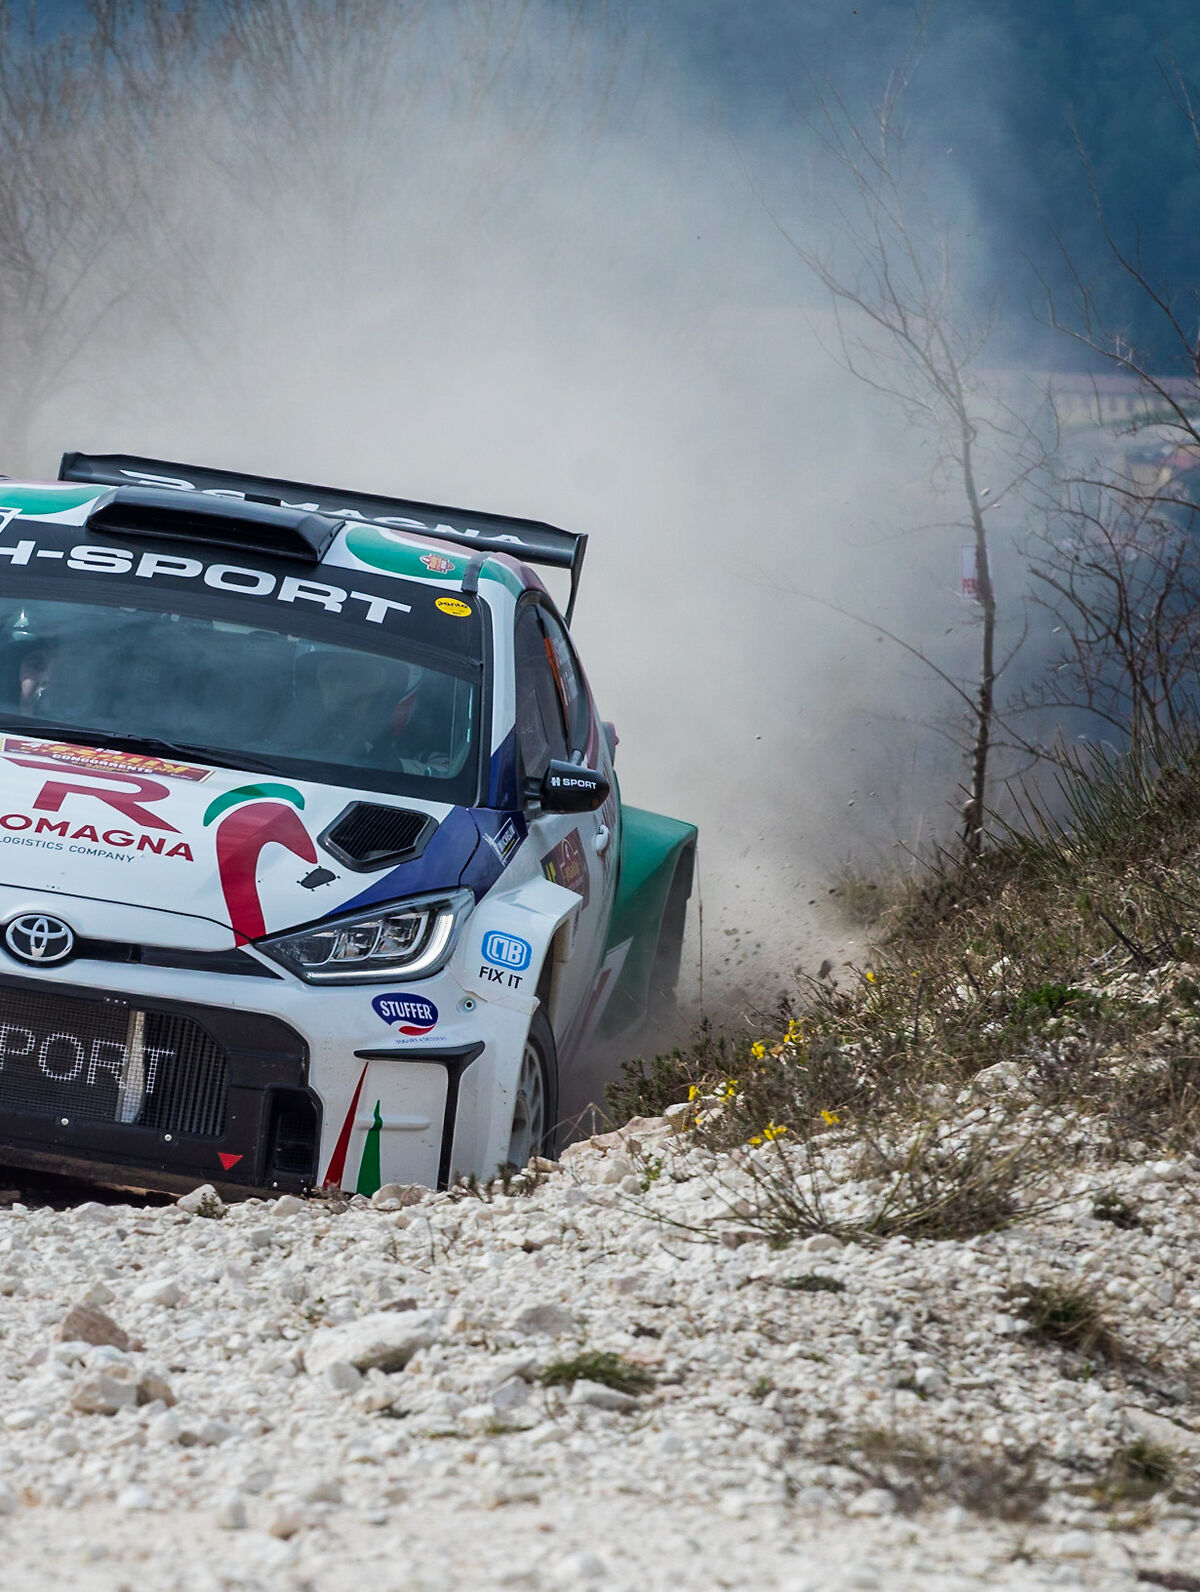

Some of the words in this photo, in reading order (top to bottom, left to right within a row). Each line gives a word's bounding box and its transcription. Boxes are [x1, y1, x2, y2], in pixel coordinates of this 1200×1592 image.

[51, 753, 154, 774] CONCORRENTE
[563, 778, 597, 790] SPORT
[1, 757, 183, 834] R
[68, 845, 136, 863] COMPANY
[479, 966, 503, 984] FIX
[508, 974, 523, 989] IT
[380, 1000, 433, 1020] STUFFER
